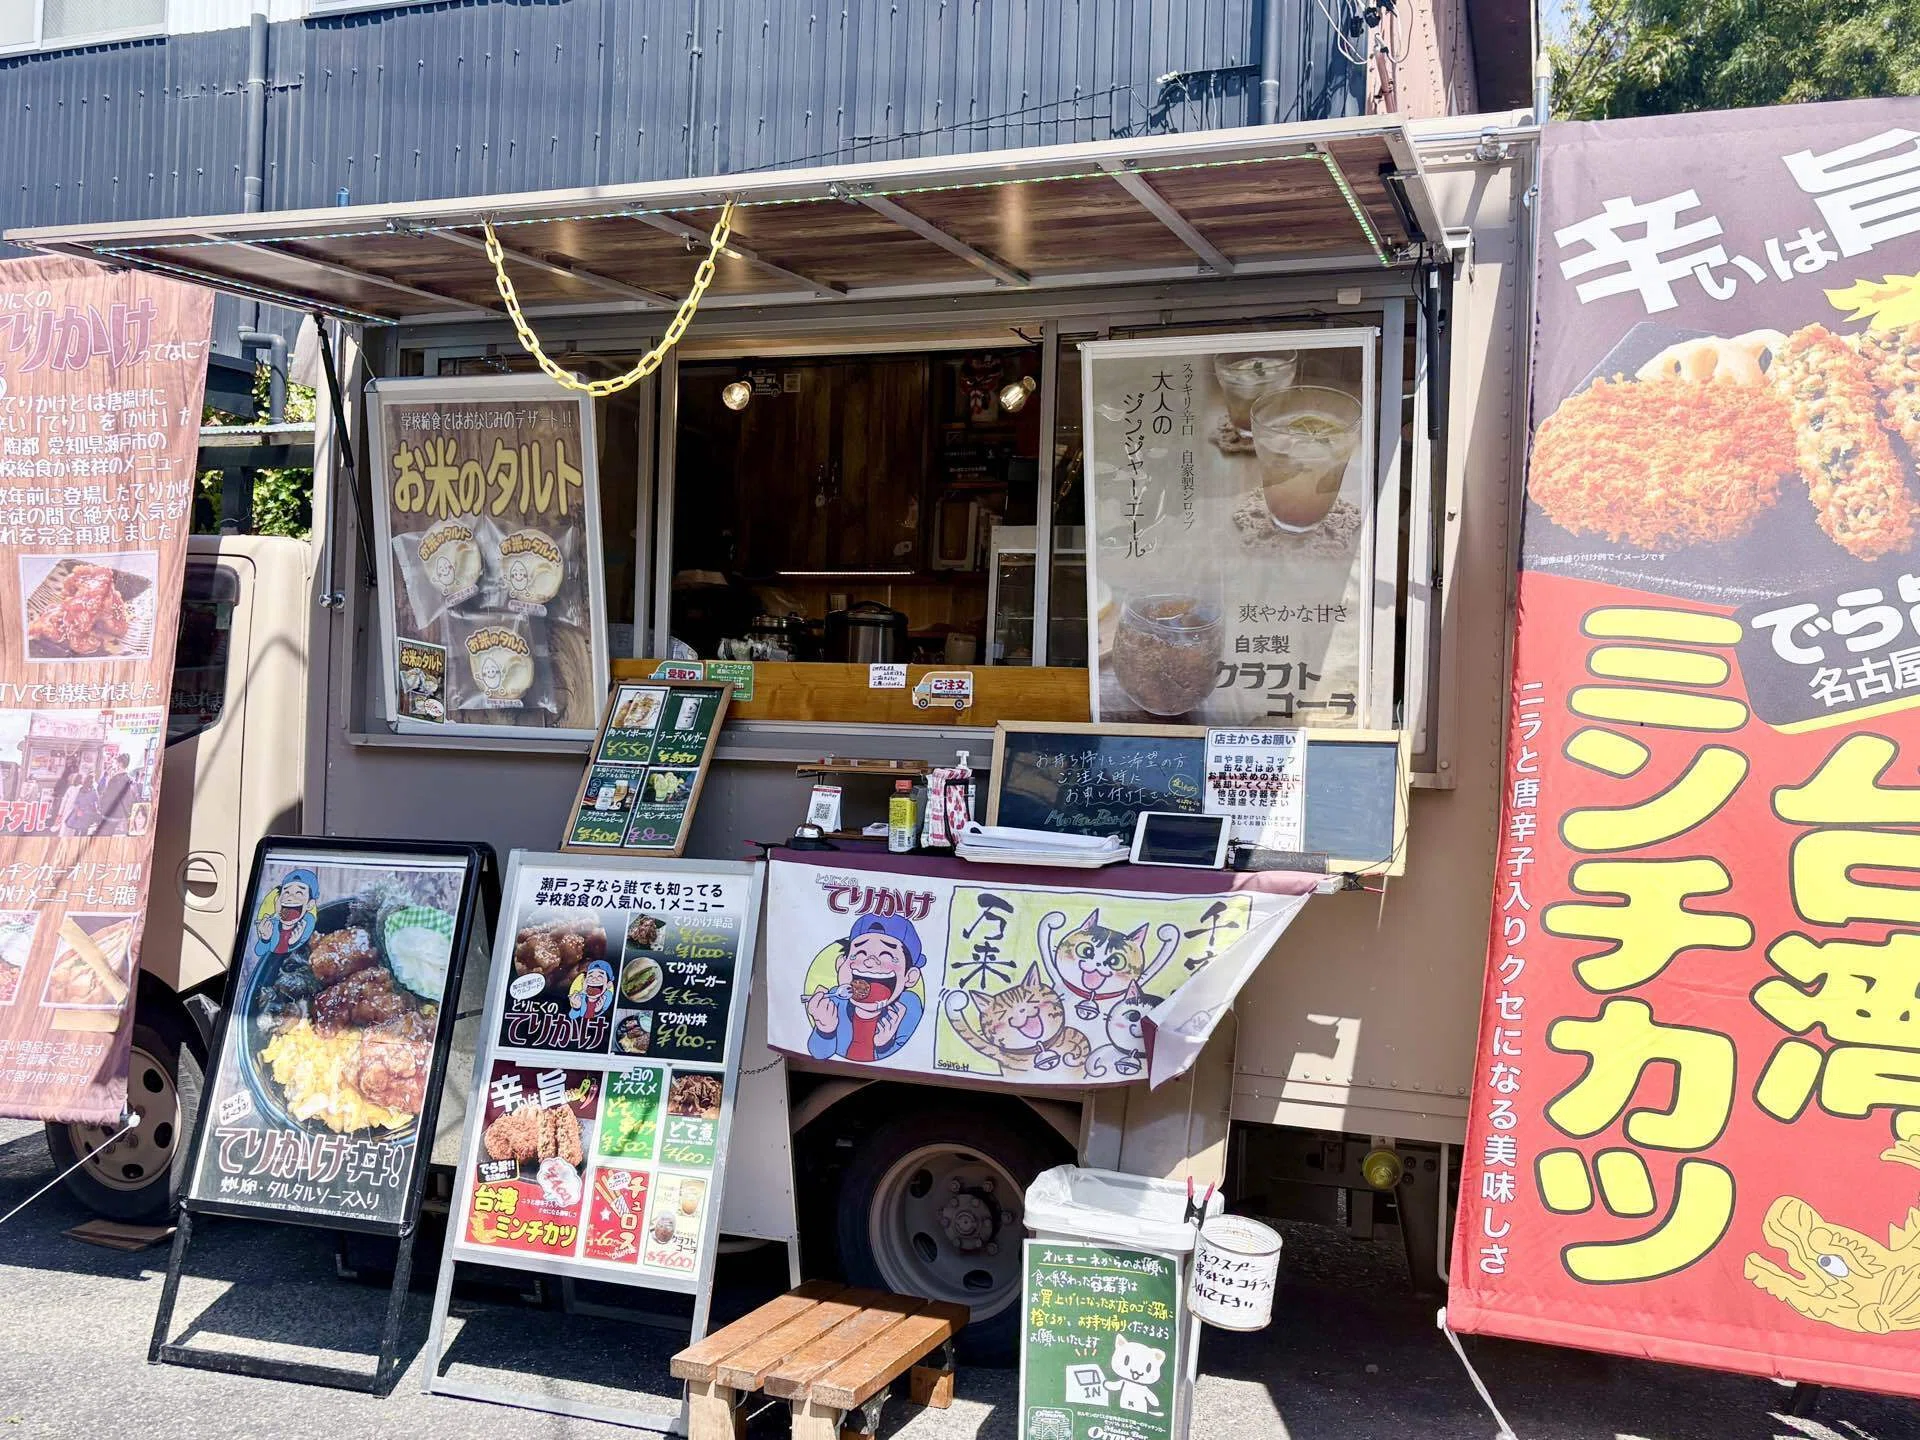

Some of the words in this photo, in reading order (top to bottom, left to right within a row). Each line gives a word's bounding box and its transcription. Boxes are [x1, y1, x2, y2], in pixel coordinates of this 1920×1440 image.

[4, 389, 168, 413] てりかけとは唐揚げに
[1151, 370, 1175, 435] 大人の
[3, 436, 41, 456] 陶都
[47, 431, 168, 456] 愛知県瀬戸市の
[392, 435, 583, 521] お米のタルト
[1123, 392, 1147, 560] ジンジャーエール
[1181, 451, 1196, 530] 自家製シロップ
[419, 525, 473, 561] お米のタルト
[500, 533, 562, 564] お米のタルト
[1238, 603, 1348, 624] 爽やかな甘さ
[1751, 573, 1920, 665] でら
[465, 628, 529, 656] お米のタルト
[1234, 635, 1291, 654] 自家製
[934, 679, 966, 690] ご注文
[1215, 661, 1321, 690] クラフト
[1266, 693, 1358, 719] コーラ
[1214, 733, 1297, 745] 店主からお願い
[540, 876, 724, 899] 瀬戸っ子なら誰でも知ってる
[535, 891, 726, 913] 学校給食の人気No.1メニュー
[822, 886, 937, 921] てりかけ
[951, 893, 1018, 990] 万来
[1183, 901, 1240, 976] 千
[1535, 607, 1755, 1286] ミンチカツ
[666, 961, 708, 975] てりかけ
[683, 974, 727, 988] バーガー
[511, 999, 559, 1014] とりにくの
[657, 1011, 708, 1027] てりかけ丼
[504, 1012, 610, 1050] てりかけ
[612, 1080, 658, 1096] オススメ
[473, 1184, 520, 1216] 台湾
[619, 1175, 649, 1252] チュロス
[496, 1215, 578, 1248] ミンチカツ
[1083, 1387, 1102, 1398] IN
